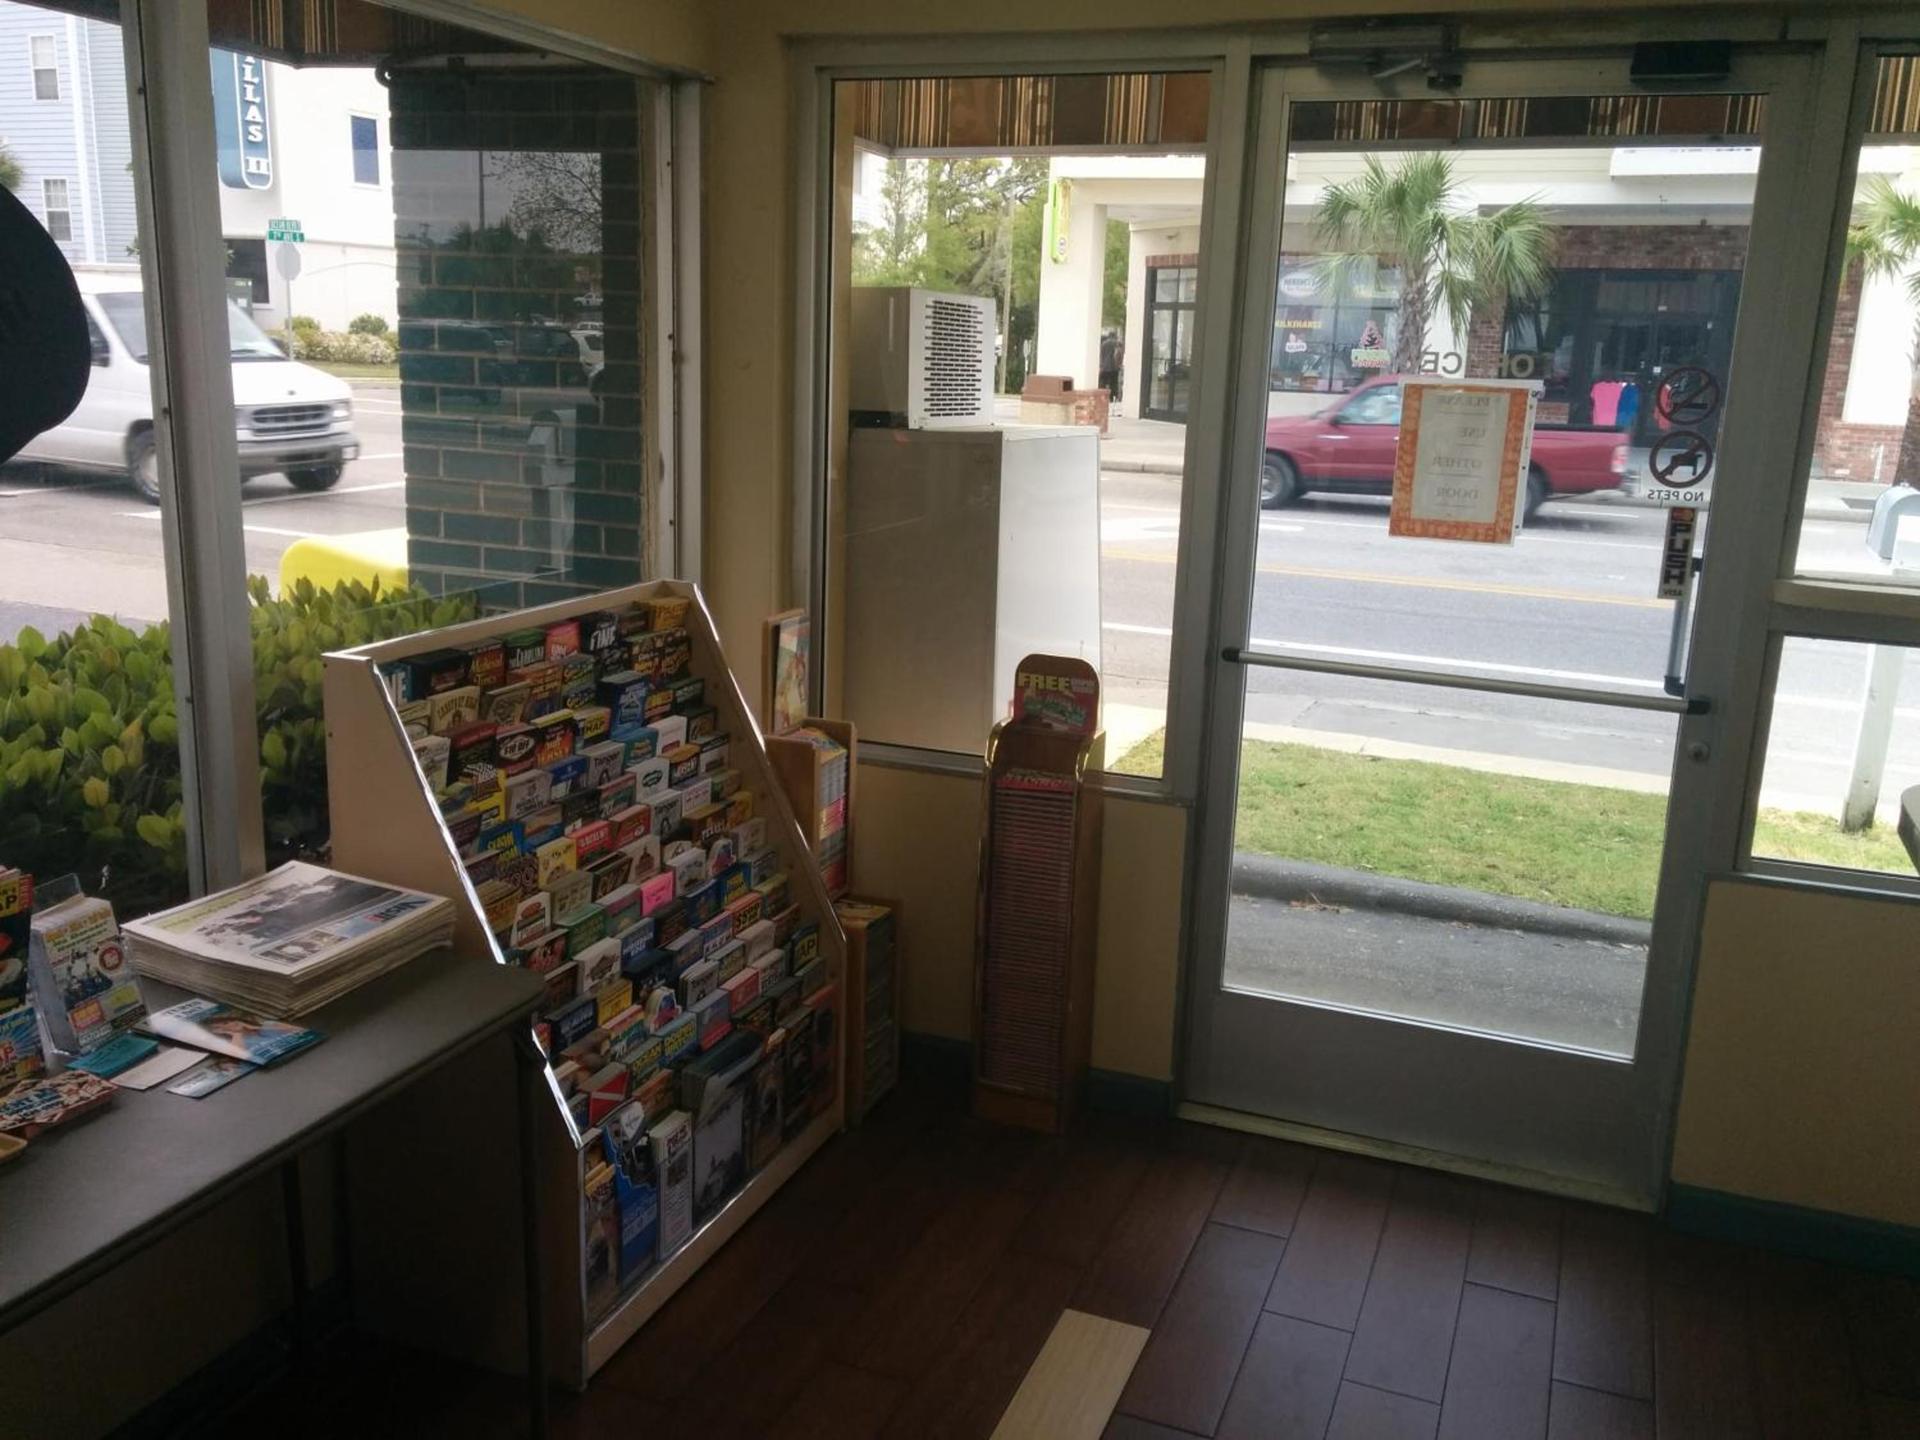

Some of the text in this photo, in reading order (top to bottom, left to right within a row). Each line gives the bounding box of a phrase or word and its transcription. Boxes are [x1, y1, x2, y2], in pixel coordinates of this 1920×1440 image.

[243, 56, 263, 142] LLAS
[1664, 523, 1692, 585] PUSH
[1018, 672, 1072, 692] FREE
